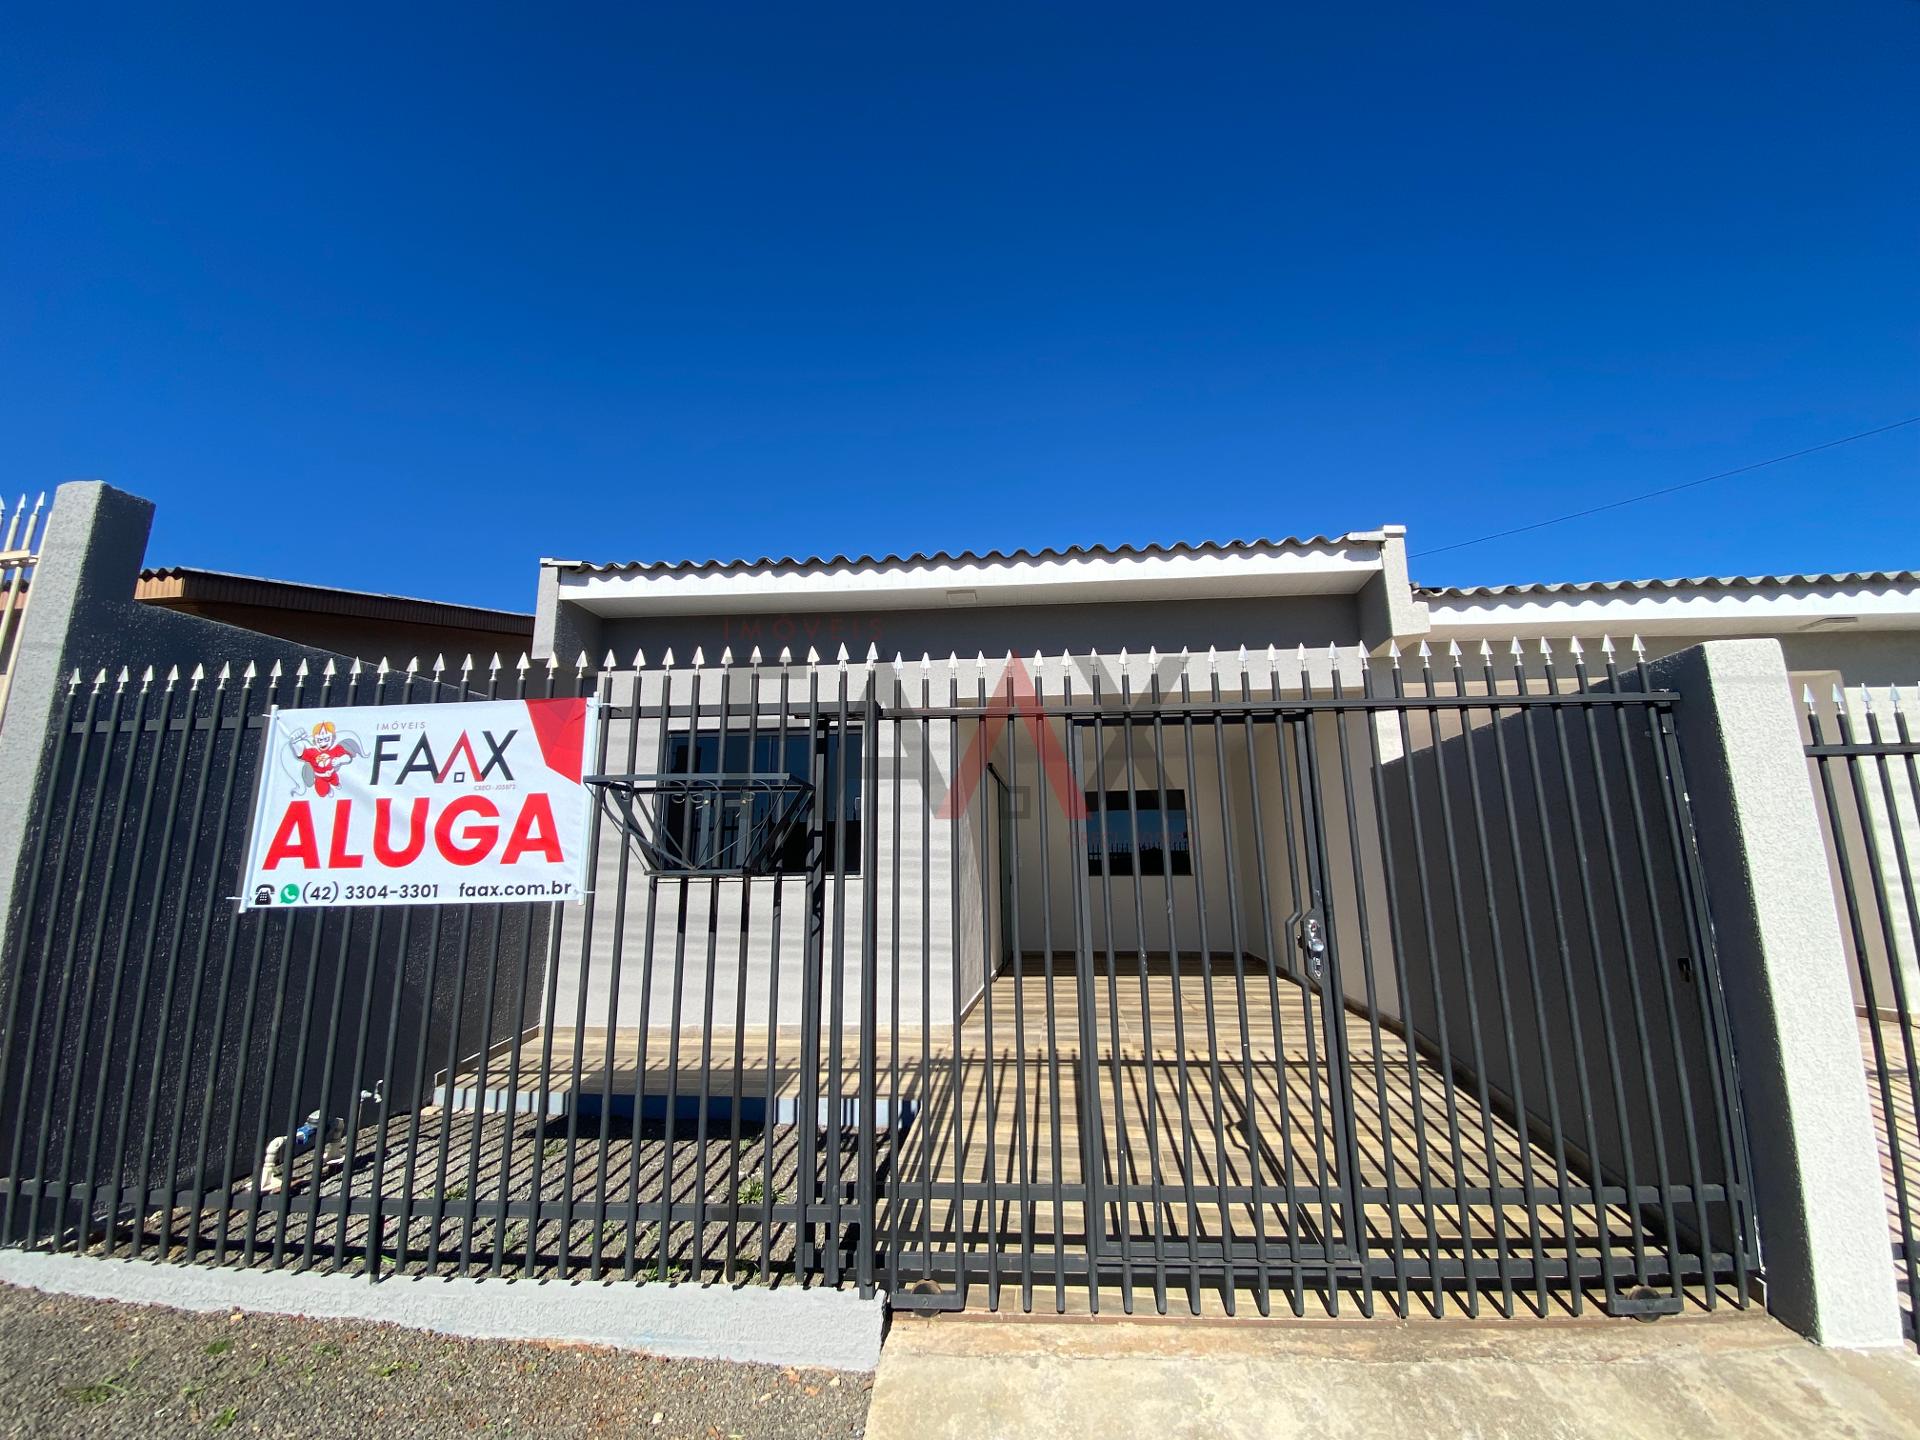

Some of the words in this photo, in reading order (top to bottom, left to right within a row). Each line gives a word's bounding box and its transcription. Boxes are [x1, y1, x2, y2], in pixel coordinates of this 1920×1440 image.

[376, 721, 427, 731] IMÓVEIS
[370, 729, 518, 785] FAAX
[262, 793, 564, 870] ALUGA
[302, 881, 338, 904] (42)
[345, 883, 438, 900] 3304-3301
[459, 881, 572, 898] faax.com.br
